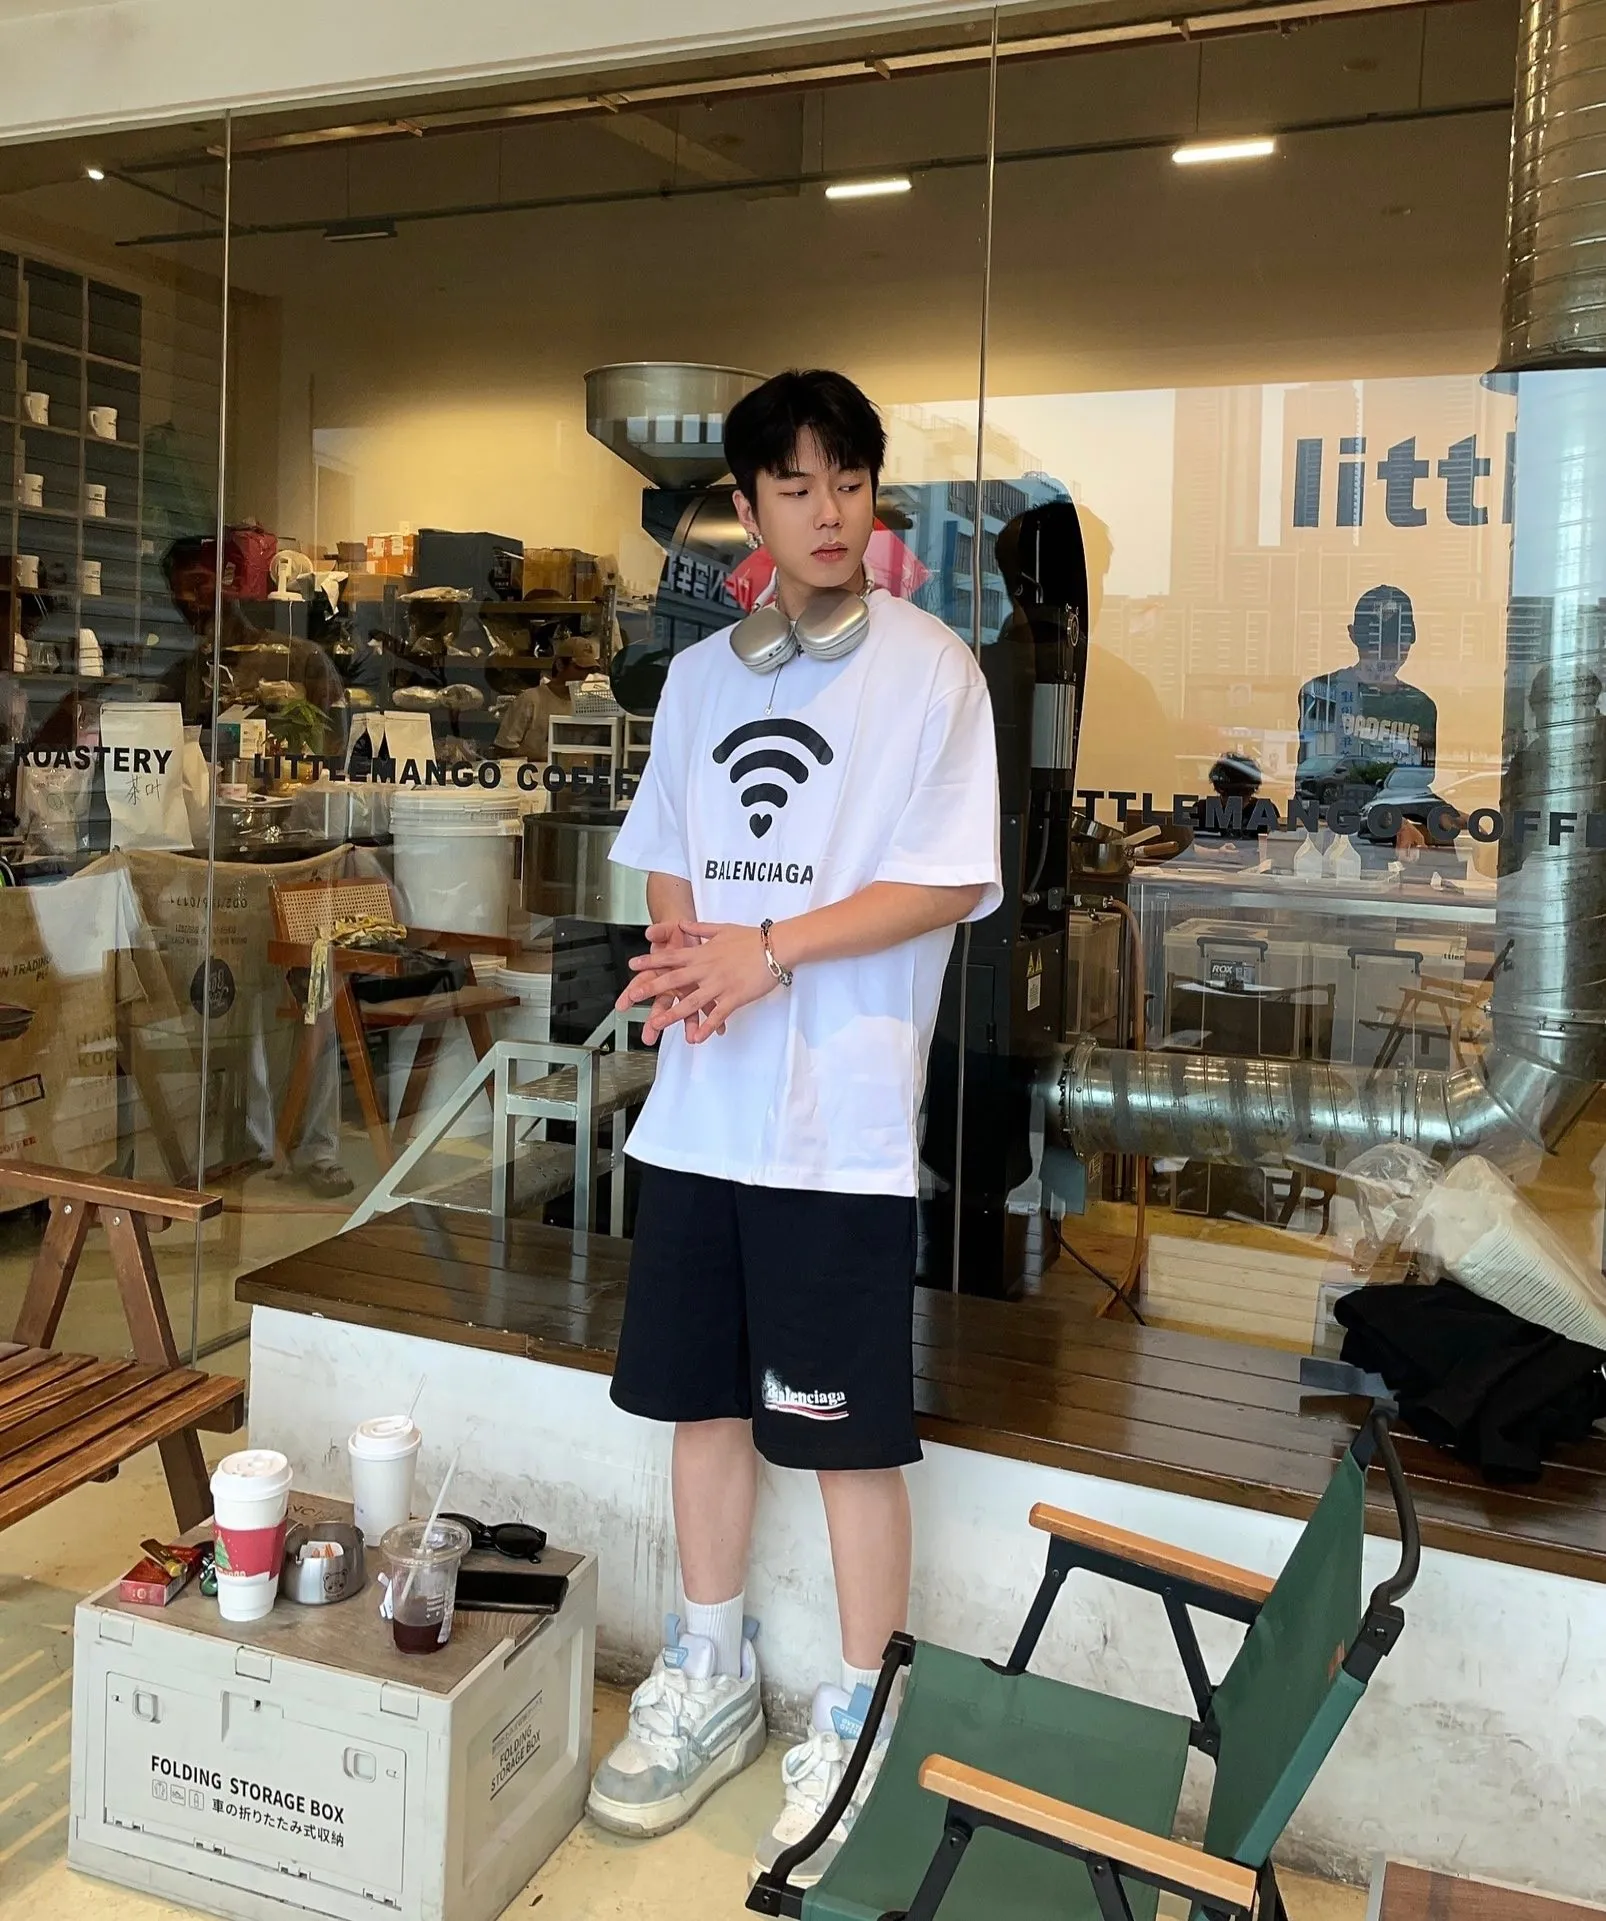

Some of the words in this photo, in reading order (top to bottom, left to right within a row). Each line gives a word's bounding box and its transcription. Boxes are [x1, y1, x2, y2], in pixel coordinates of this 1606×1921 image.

[14, 743, 172, 774] ROASTERY
[254, 753, 501, 789] LITTLEMANGO
[1060, 789, 1402, 837] TTLEMANGO
[704, 859, 814, 885] BALENCIAGA
[1212, 964, 1233, 974] ROX
[490, 1746, 526, 1793] STORAGE
[526, 1729, 541, 1755] BOX
[500, 1724, 532, 1768] FOLDING
[151, 1755, 222, 1790] FOLDING
[229, 1777, 306, 1814] STORAGE
[310, 1799, 345, 1825] BOX
[211, 1797, 345, 1848] 車の折りたたみ式収納
